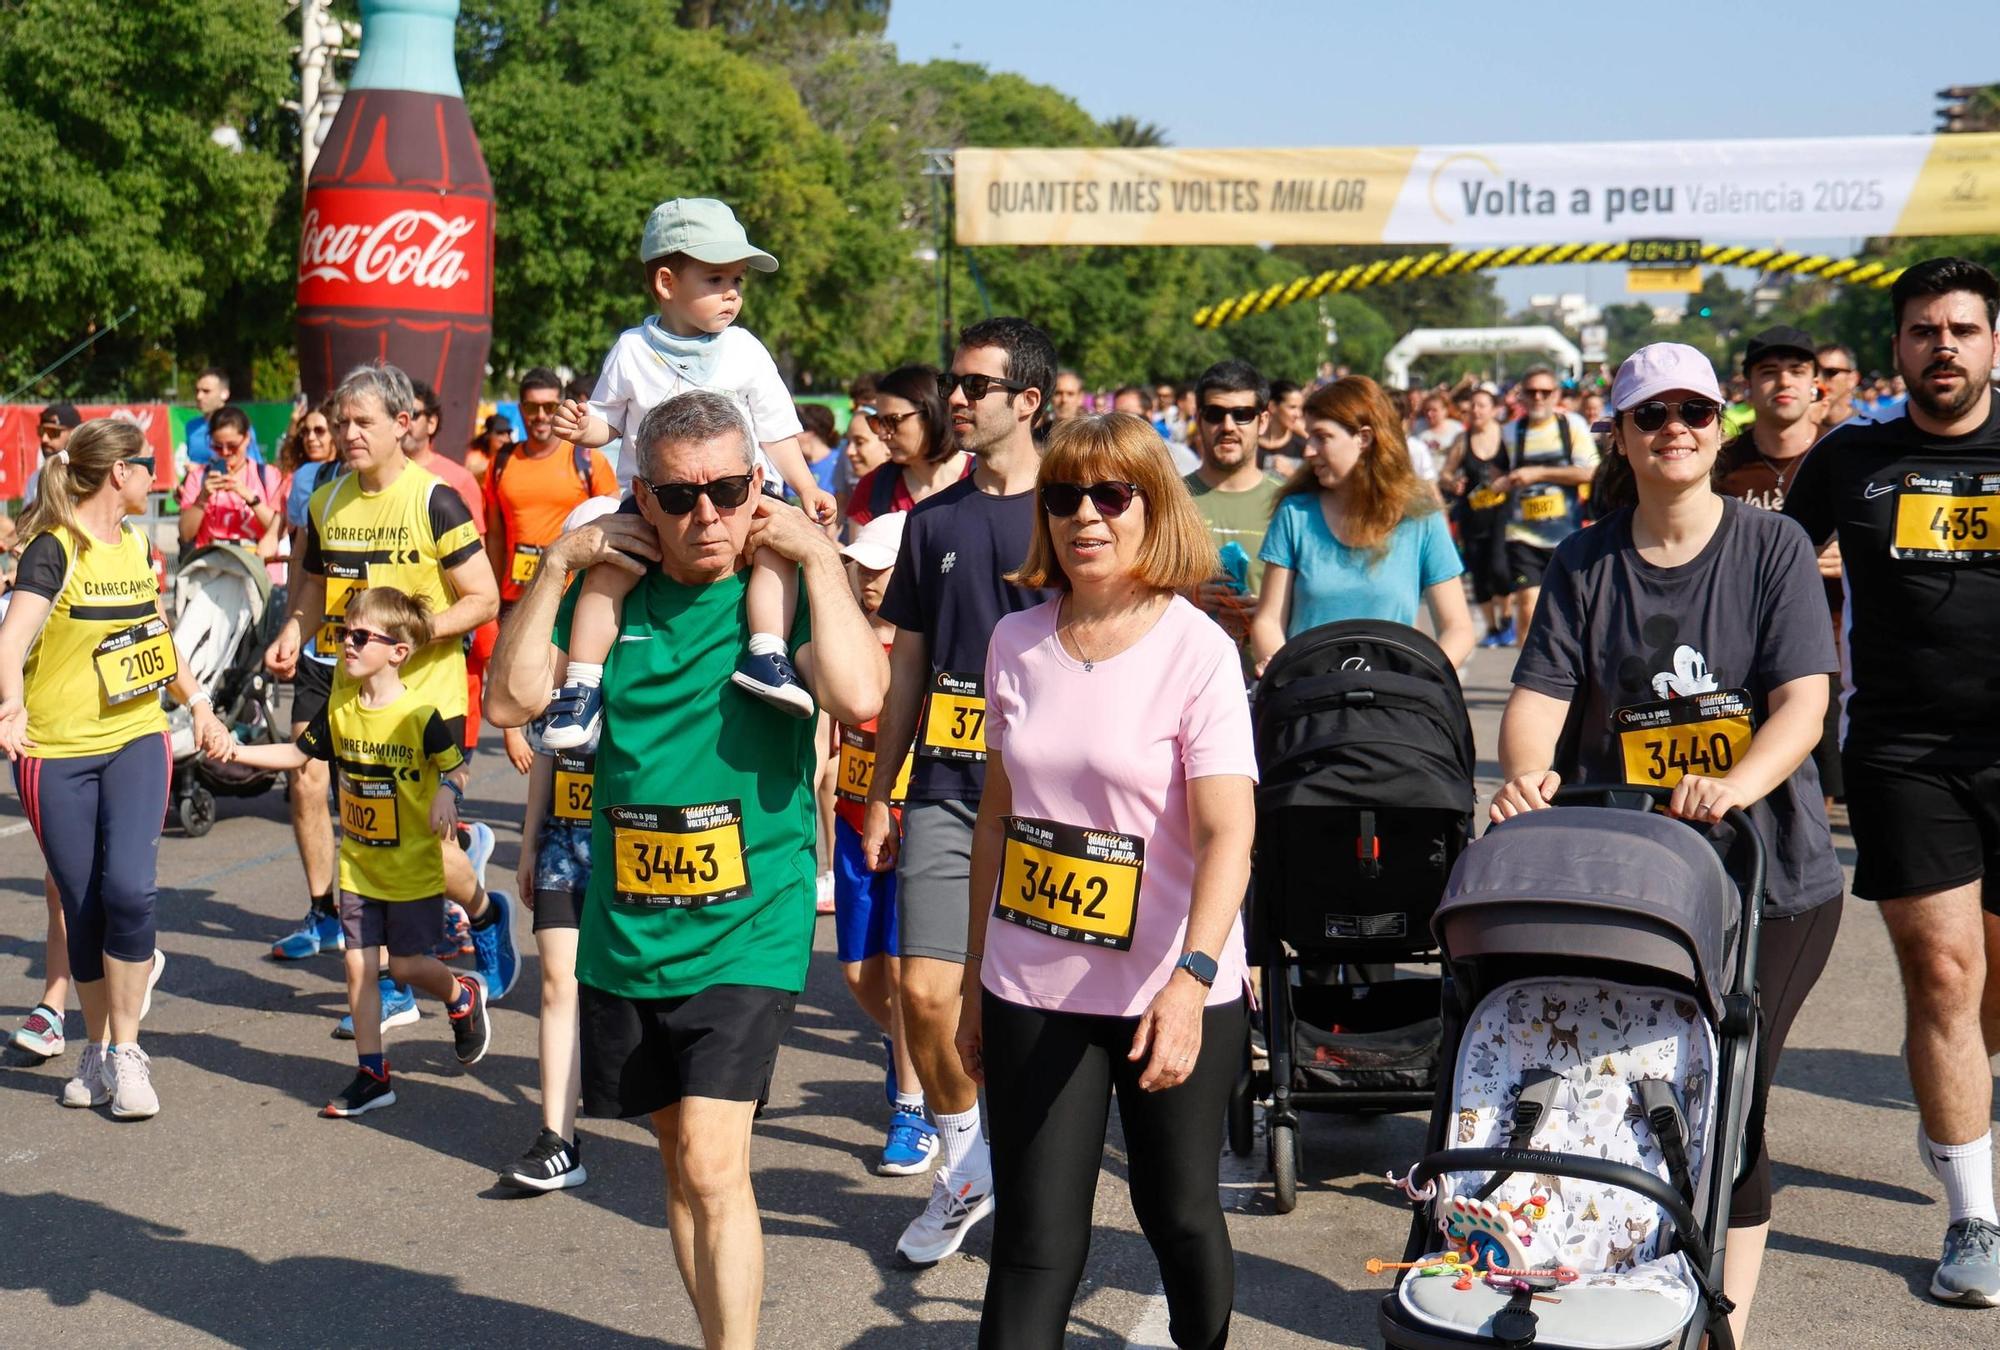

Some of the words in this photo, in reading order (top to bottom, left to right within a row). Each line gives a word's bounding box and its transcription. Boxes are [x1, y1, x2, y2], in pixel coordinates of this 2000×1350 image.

[988, 180, 1099, 216] QUANTES
[1110, 174, 1161, 212] MÉS
[1171, 180, 1259, 212] VOLTES
[1270, 179, 1367, 212] MILLOR
[1461, 180, 1555, 216] Volta
[1569, 189, 1591, 216] a
[1605, 186, 1674, 222] peu
[1685, 182, 1804, 213] València
[1813, 180, 1884, 212] 2025
[1930, 506, 1988, 540] 435
[84, 577, 154, 596] CRRECAM
[120, 646, 164, 683] 2105
[943, 677, 959, 686] Volta
[964, 681, 976, 689] peu
[951, 706, 985, 741] 37
[1625, 712, 1647, 722] Volta
[1654, 708, 1670, 720] peu
[1645, 732, 1733, 780] 3440
[346, 800, 378, 832] 2102
[619, 810, 638, 820] Volta
[644, 812, 657, 822] peu
[687, 808, 715, 819] QUANTES
[715, 804, 729, 814] MÉS
[687, 818, 710, 828] VOLTES
[710, 813, 733, 824] MILLOR
[1016, 820, 1035, 835] Volta
[1035, 828, 1040, 836] a
[1040, 829, 1054, 840] peu
[1088, 836, 1119, 849] QUANTES
[1119, 838, 1133, 850] MÉS
[633, 843, 719, 883] 3443
[1087, 845, 1110, 858] VOLTES
[1110, 850, 1136, 860] MILLOR
[1021, 858, 1108, 920] 3442
